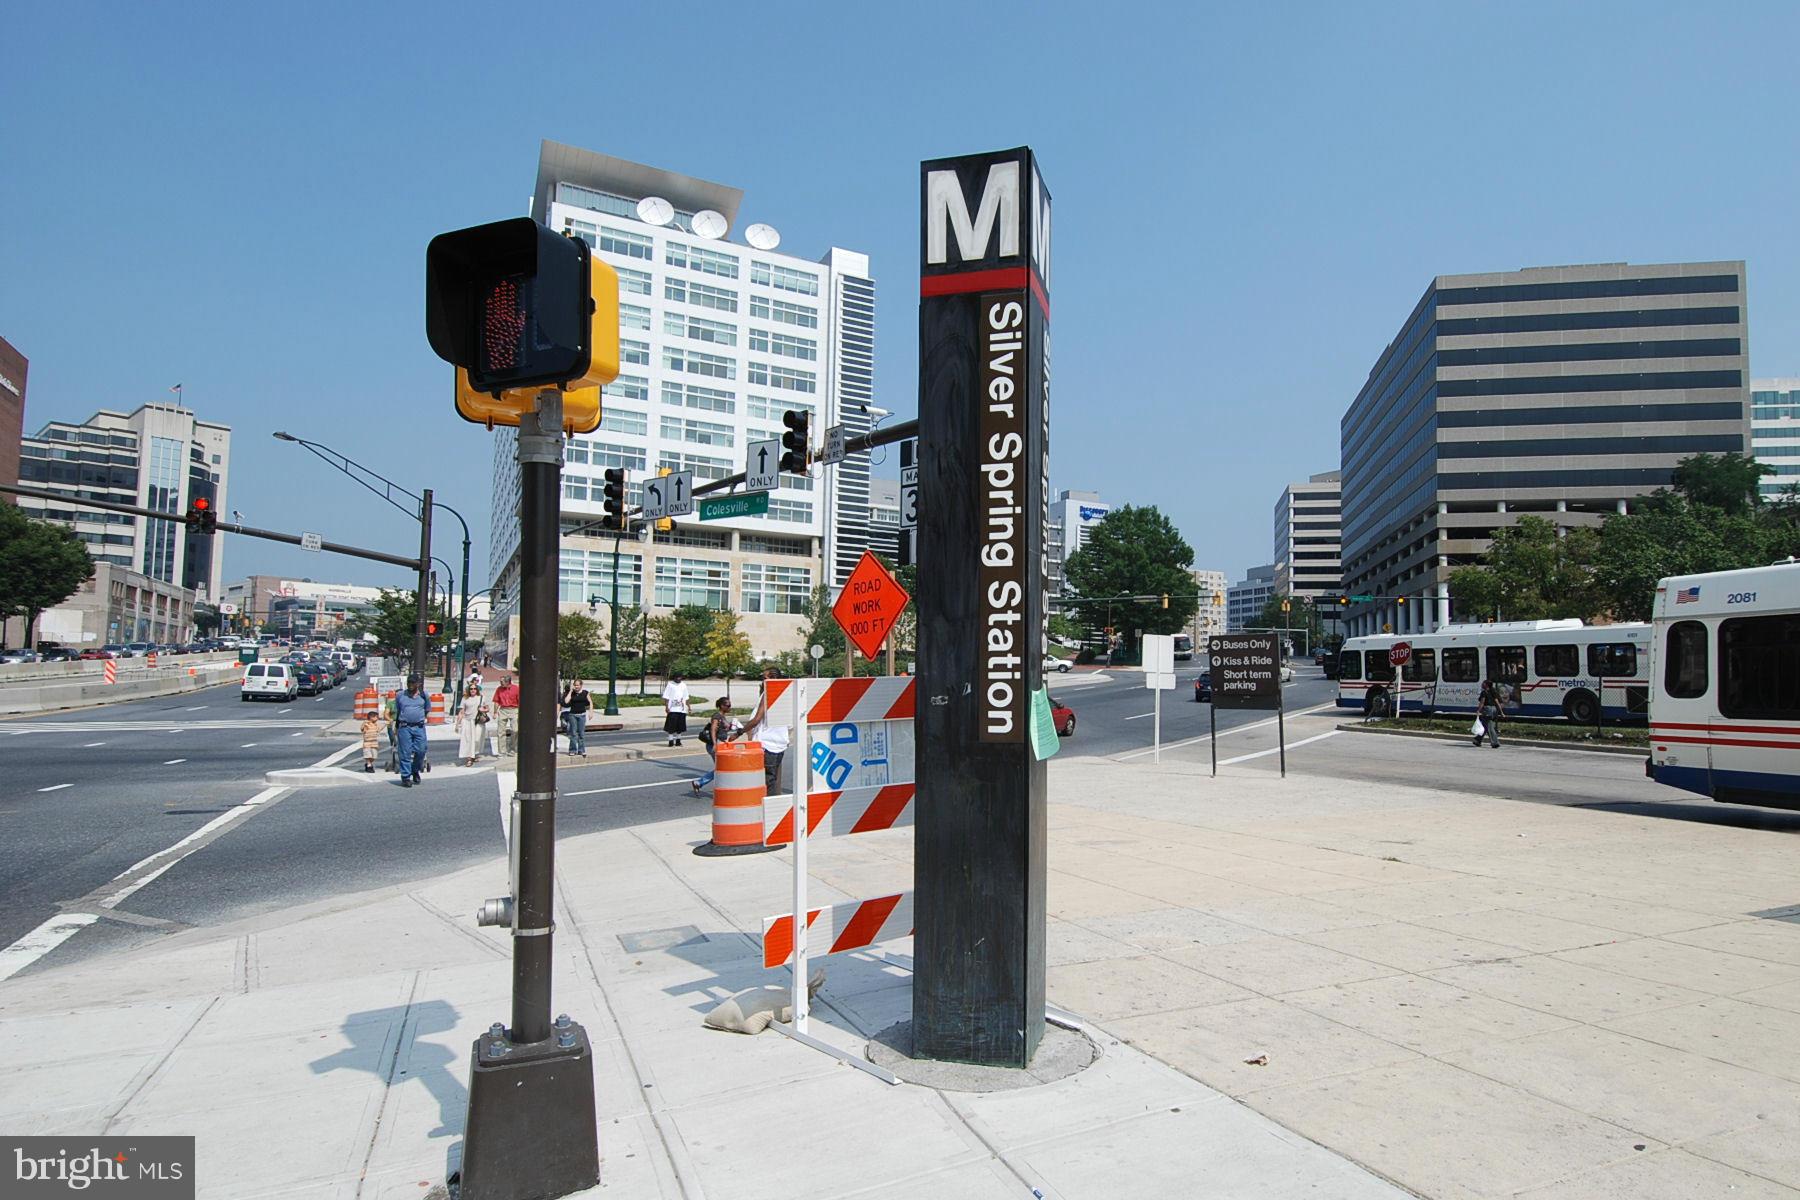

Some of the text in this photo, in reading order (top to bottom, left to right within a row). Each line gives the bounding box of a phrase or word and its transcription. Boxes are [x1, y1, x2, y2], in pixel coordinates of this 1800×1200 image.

[927, 160, 1019, 264] M
[1032, 164, 1050, 293] M
[750, 475, 774, 487] ONLY
[645, 508, 662, 518] ONLY
[670, 503, 688, 513] ONLY
[706, 502, 749, 516] Colesville
[981, 302, 1023, 734] Silver Spring Station
[853, 579, 882, 595] ROAD
[1727, 592, 1757, 604] 2081
[853, 599, 881, 615] WORK
[850, 617, 885, 636] 1000 FT
[1222, 639, 1271, 650] Buses Only
[1390, 648, 1410, 660] STOP
[1223, 656, 1273, 666] Kiss & Ride
[1223, 670, 1272, 679] Short term
[1223, 681, 1256, 691] parking
